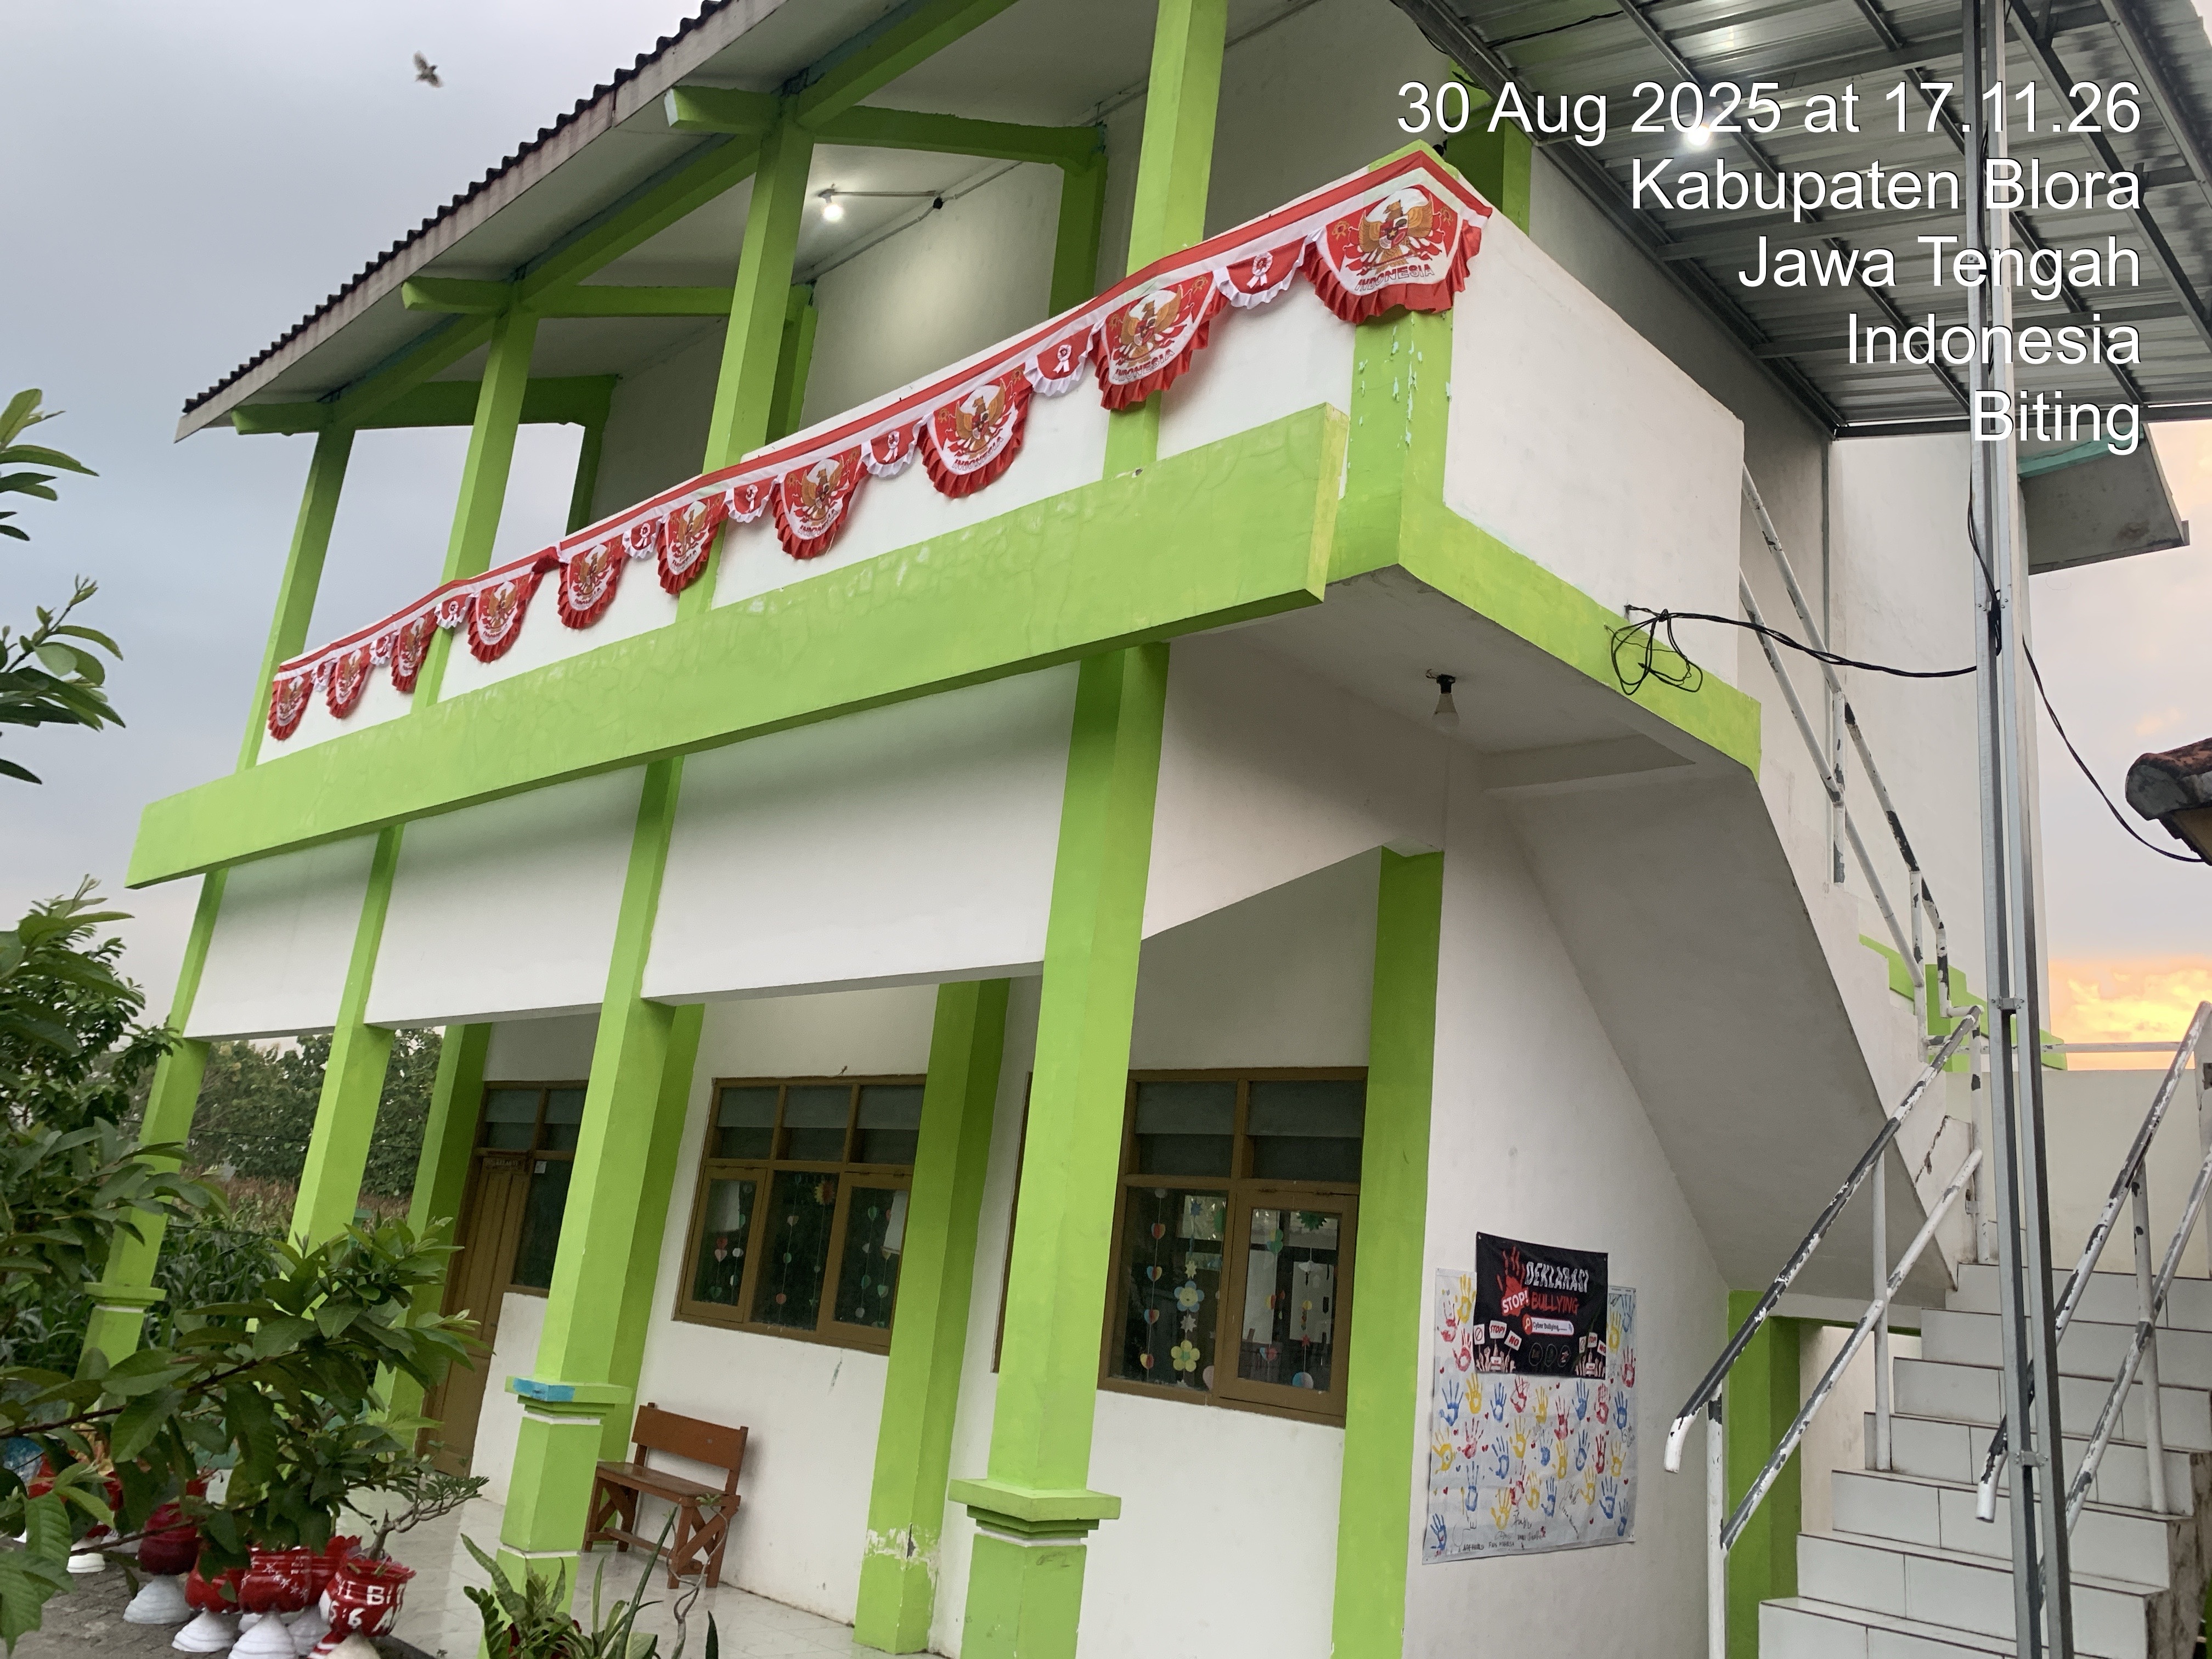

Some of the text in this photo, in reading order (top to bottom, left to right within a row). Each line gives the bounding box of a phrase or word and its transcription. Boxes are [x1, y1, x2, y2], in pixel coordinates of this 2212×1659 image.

[1355, 264, 1435, 292] INDONESIA
[1112, 348, 1175, 382] INDONESIA
[1525, 1262, 1589, 1293] DEKLARASI
[1502, 1290, 1579, 1315] STOP! BULLYING
[1490, 1324, 1505, 1334] STOP!
[1509, 1335, 1520, 1347] NO
